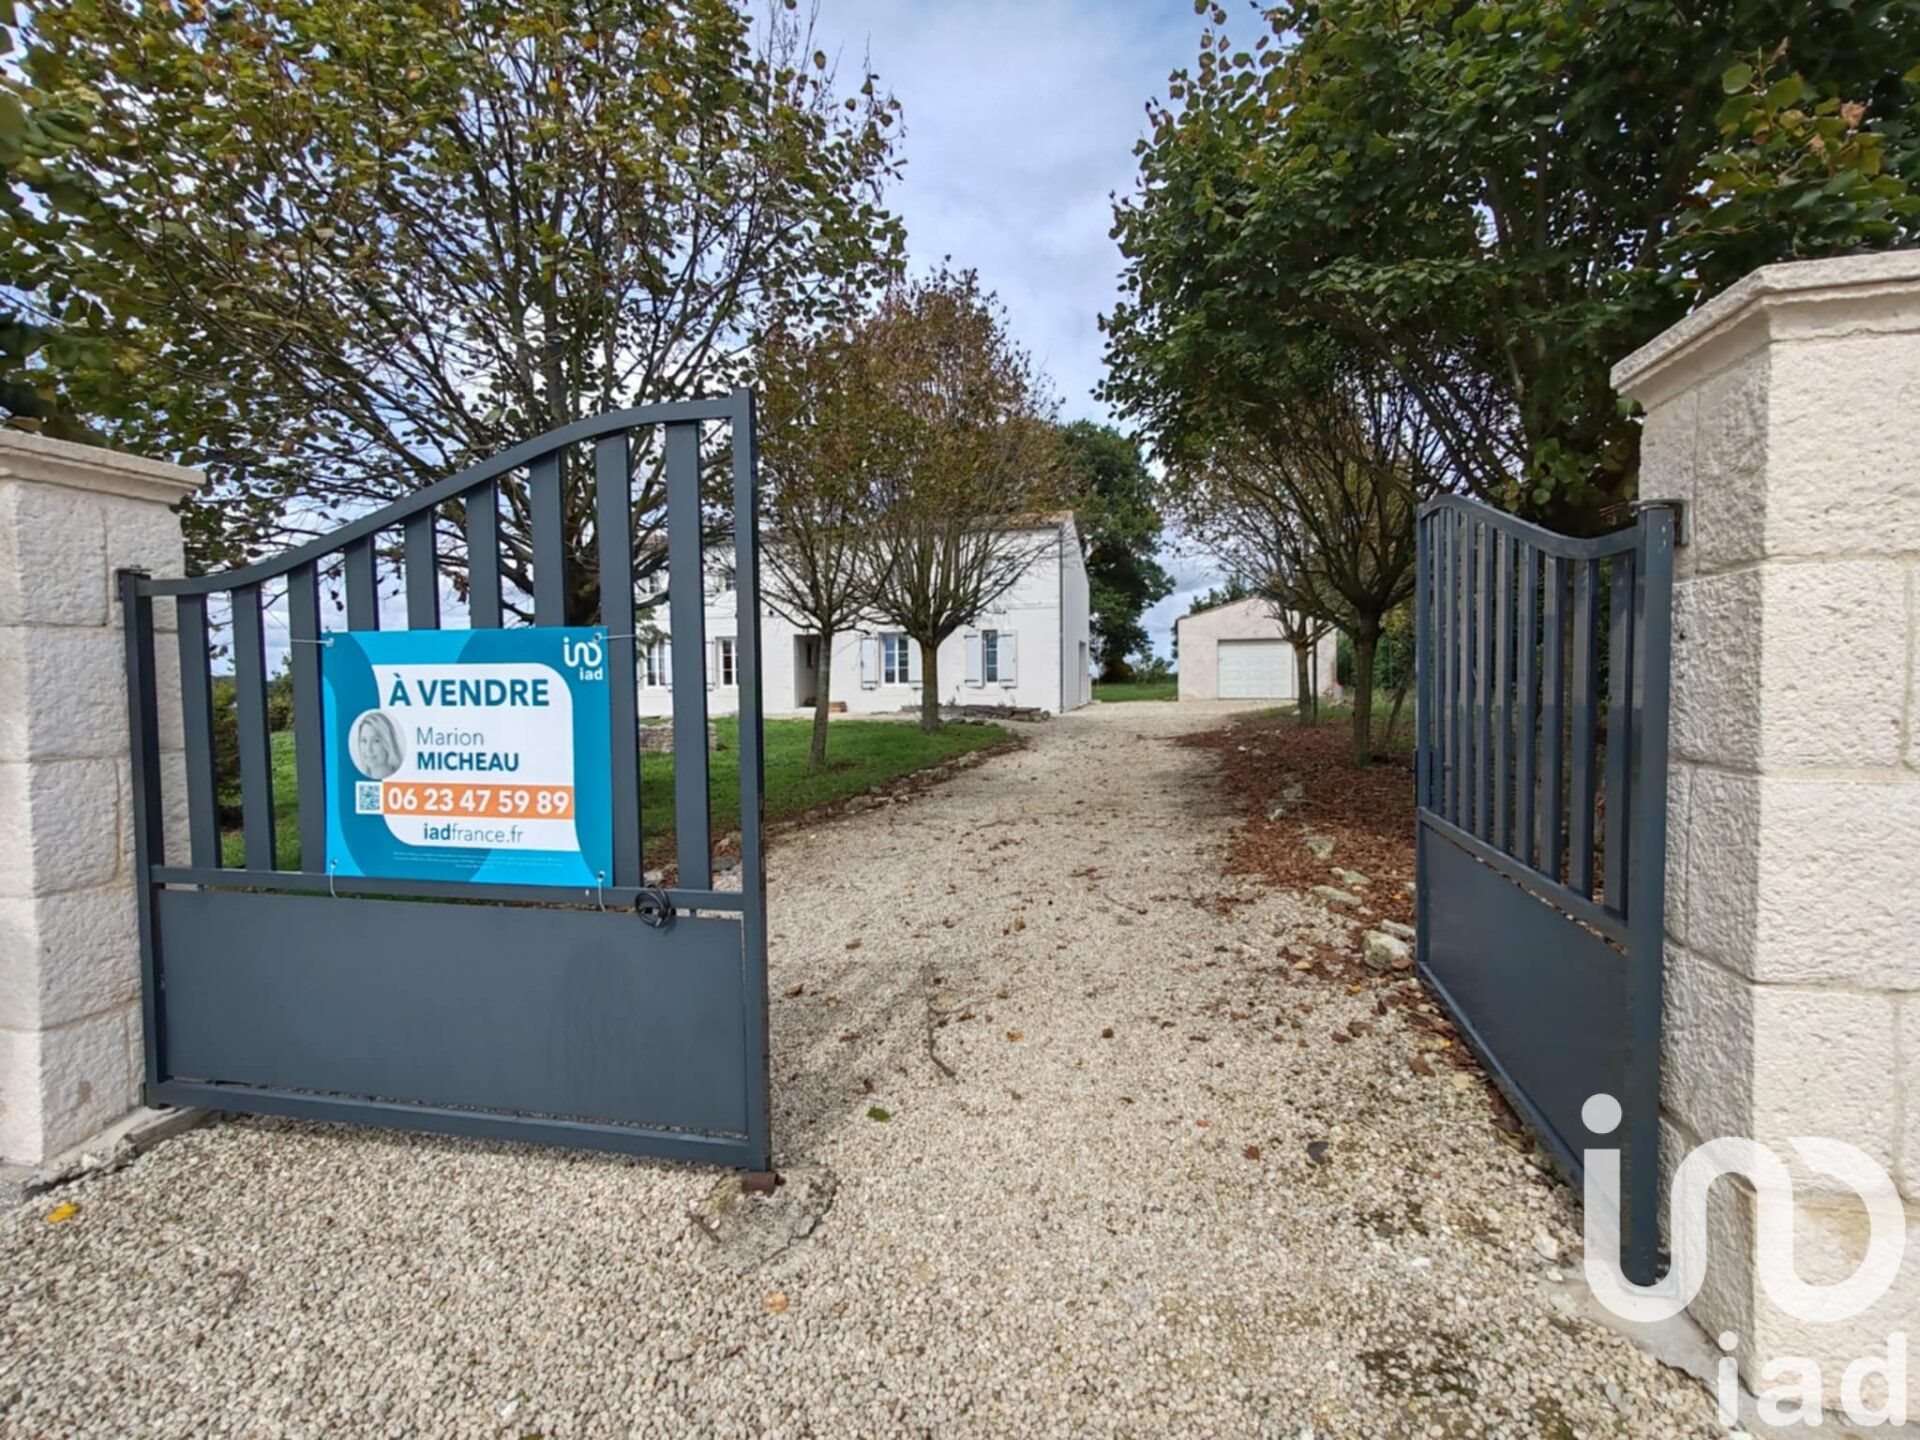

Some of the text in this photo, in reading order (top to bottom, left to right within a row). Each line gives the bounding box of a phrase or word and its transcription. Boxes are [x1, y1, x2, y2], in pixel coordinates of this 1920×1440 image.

[579, 667, 603, 681] iad
[388, 673, 550, 707] À VENDRE
[416, 727, 485, 747] Marion
[417, 752, 520, 772] MICHEAU
[388, 788, 570, 814] 06 23 47 59 89
[423, 823, 524, 844] iadfrance.fr
